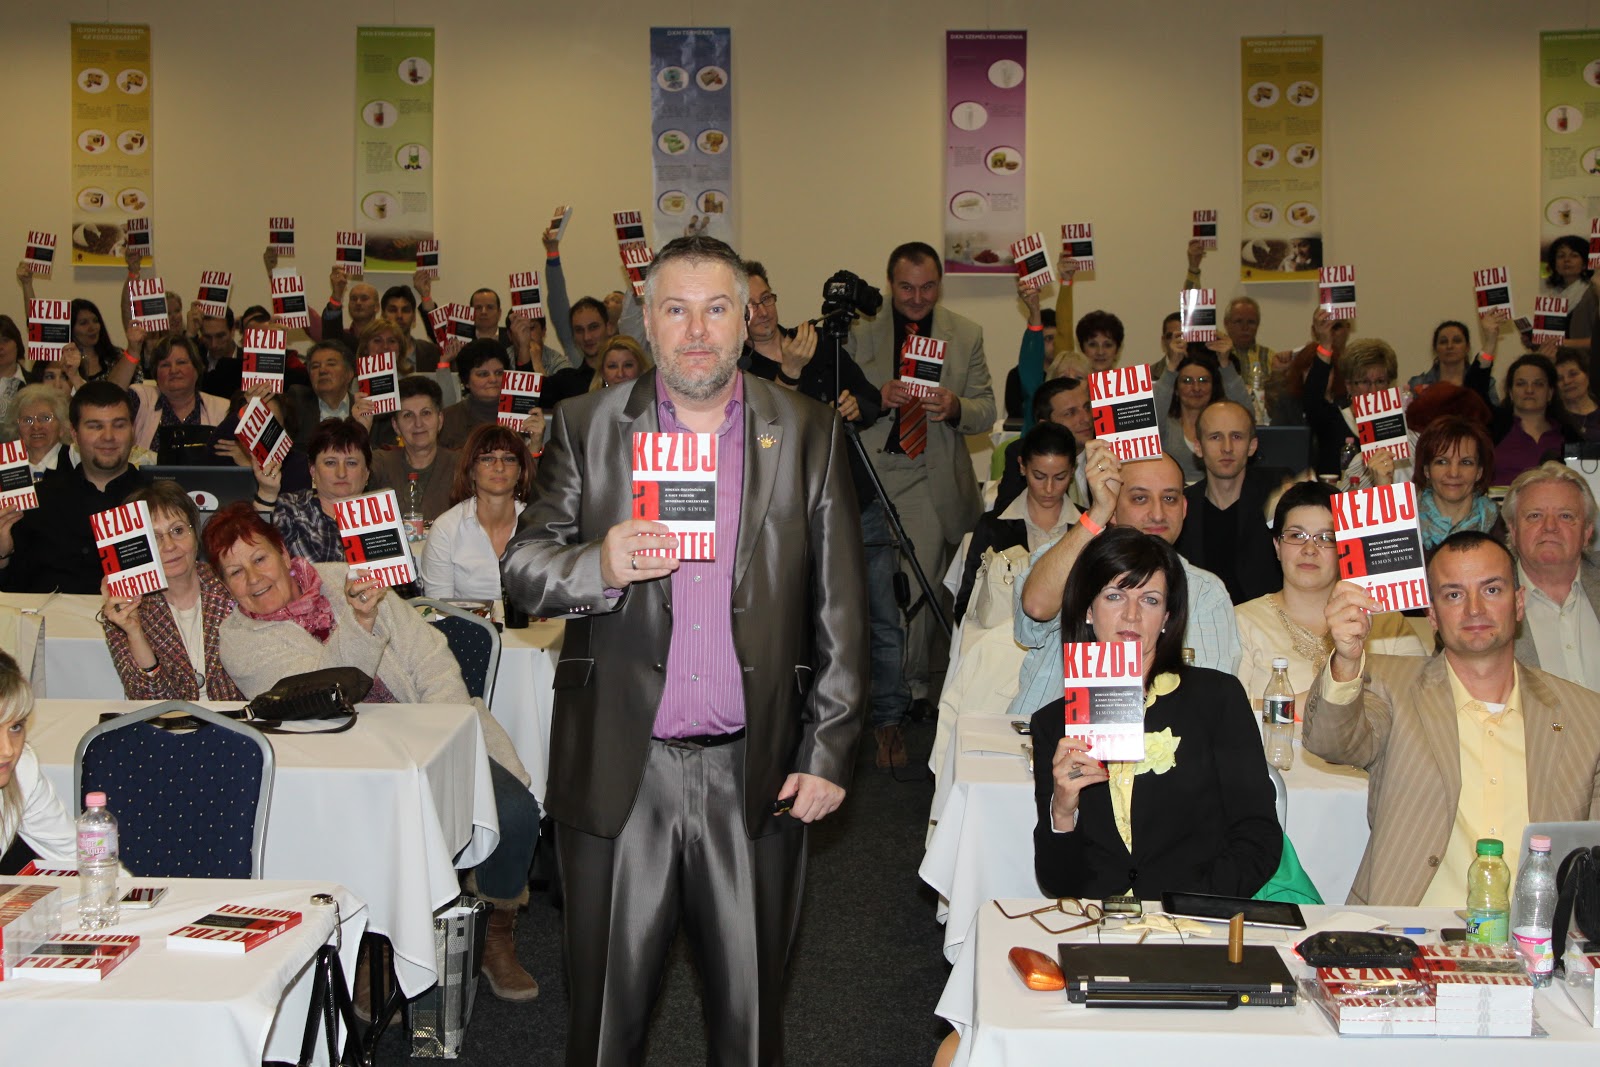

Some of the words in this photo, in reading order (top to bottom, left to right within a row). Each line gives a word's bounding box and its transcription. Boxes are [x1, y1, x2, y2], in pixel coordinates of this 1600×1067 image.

[270, 217, 295, 230] KEZDJ
[614, 211, 641, 225] KEZDJ
[28, 231, 57, 247] KEZDJ
[337, 231, 363, 246] KEZDJ
[1062, 224, 1092, 240] KEZDJ
[416, 240, 439, 252] KEZDJ
[1011, 233, 1042, 259] KEZDJ
[621, 248, 655, 264] KEZDJ
[201, 271, 232, 286] KEZDJ
[509, 271, 539, 288] KEZDJ
[1319, 266, 1355, 284] KEZDJ
[1474, 267, 1506, 287] KEZDJ
[130, 278, 165, 297] KEZDJ
[272, 276, 304, 294] KEZDJ
[29, 300, 71, 320] KEZDJ
[448, 303, 476, 321] KEZDJ
[1535, 297, 1568, 313] KEZDJ
[243, 329, 287, 350] KEZDJ
[905, 336, 947, 361] KEZDJ
[357, 352, 394, 376] KEZDJ
[501, 372, 543, 393] KEZDJ
[1088, 364, 1152, 401] KEZDJ
[1353, 387, 1402, 417] KEZDJ
[239, 399, 272, 448] KEZDJ
[633, 433, 716, 472] KEZDJ
[334, 494, 395, 531] KEZDJ
[1330, 482, 1415, 532] KEZDJ
[90, 501, 144, 542] KEZDJ
[1371, 558, 1392, 566] SIMON
[1394, 555, 1413, 563] SINEK
[1064, 642, 1142, 678] KEZDJ
